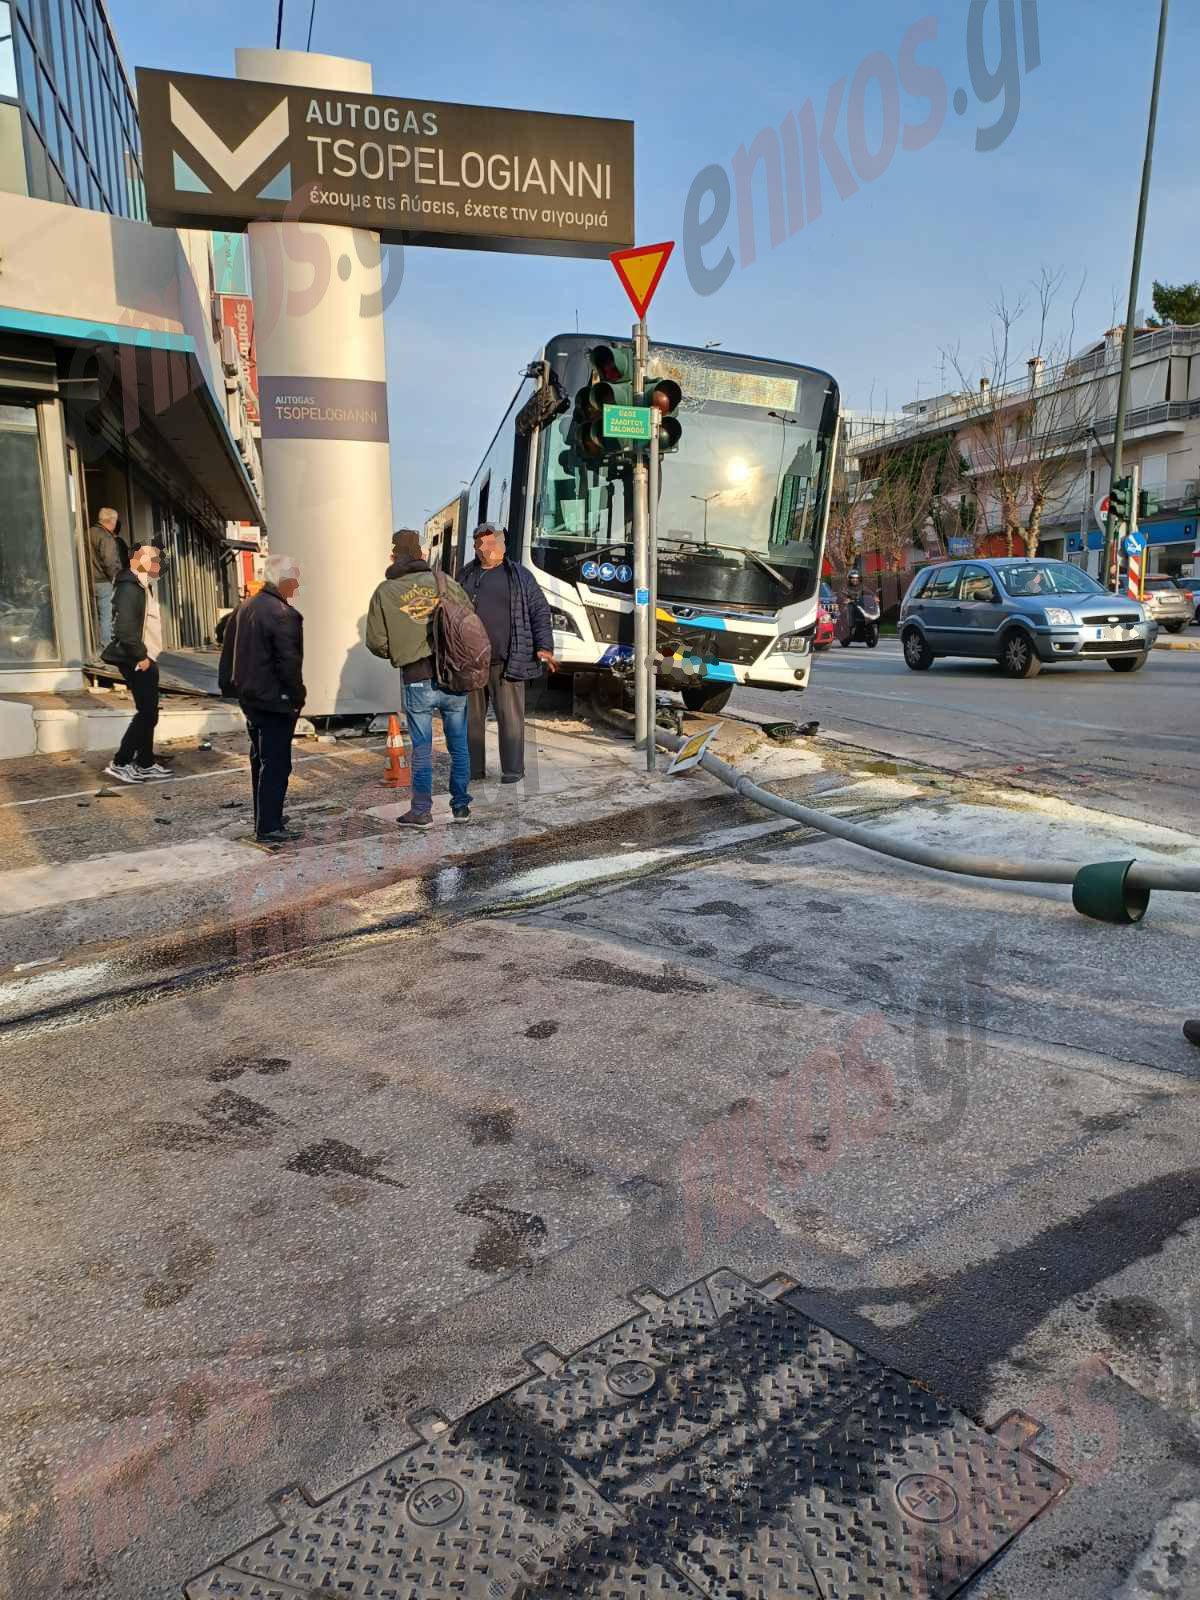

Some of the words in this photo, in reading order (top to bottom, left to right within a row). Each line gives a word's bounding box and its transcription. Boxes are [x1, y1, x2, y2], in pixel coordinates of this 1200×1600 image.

[305, 99, 439, 136] AUTOGAS
[306, 136, 611, 200] TSOPELOGIANNI
[309, 185, 372, 212] έχουμε
[374, 195, 396, 211] τις
[400, 194, 460, 218] λύσεις,
[464, 199, 508, 219] έχετε
[511, 206, 538, 222] την
[541, 210, 608, 229] σιγουριά
[275, 395, 315, 405] AUTOGAS
[275, 406, 377, 424] TSOPELOGIANNI
